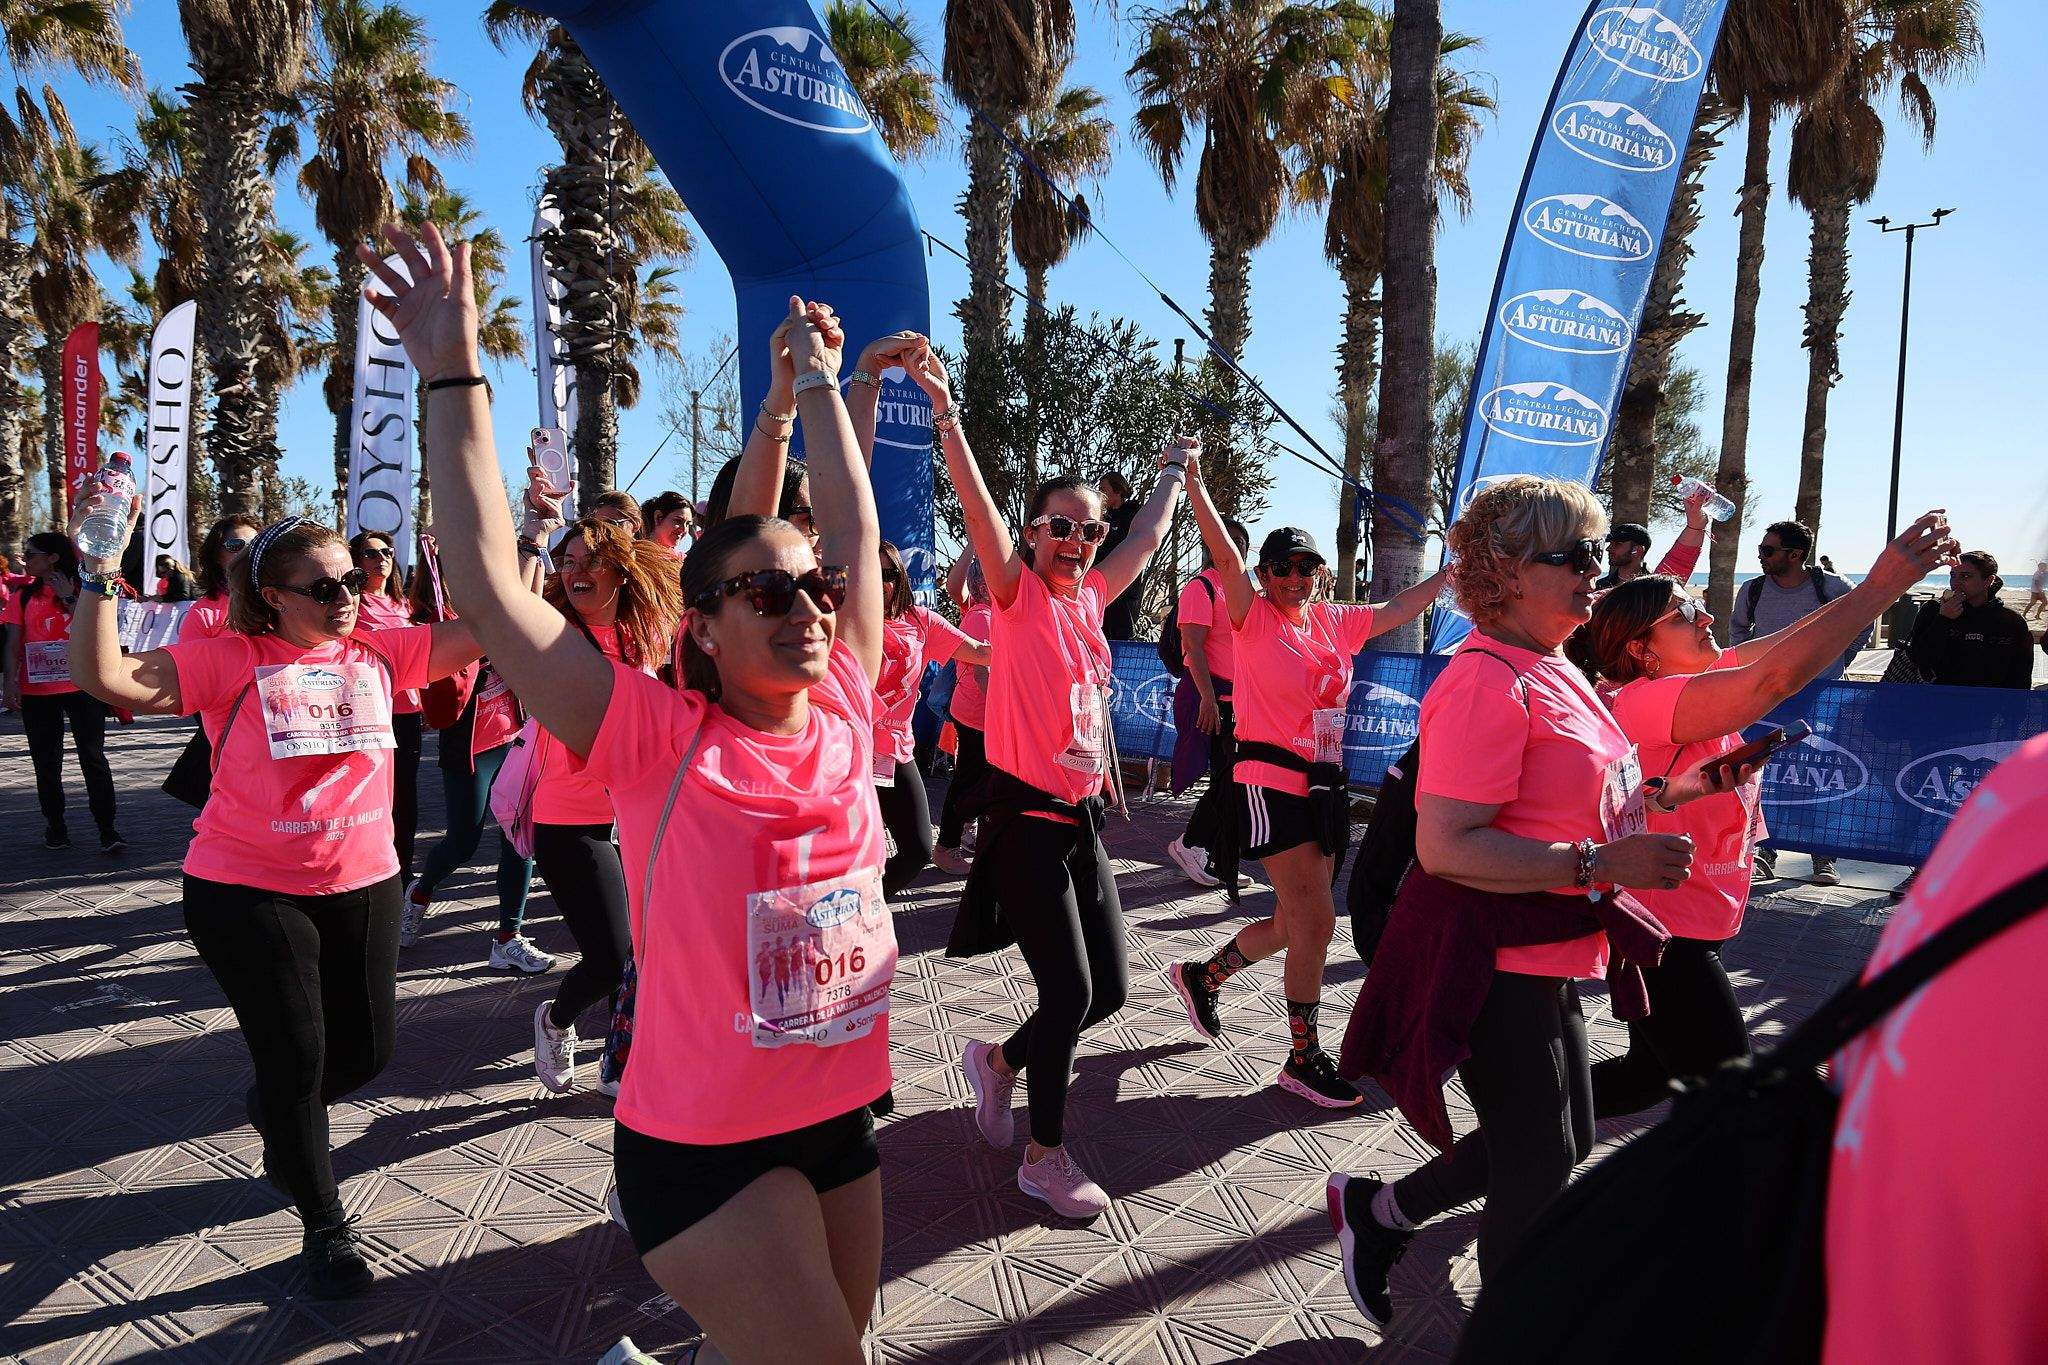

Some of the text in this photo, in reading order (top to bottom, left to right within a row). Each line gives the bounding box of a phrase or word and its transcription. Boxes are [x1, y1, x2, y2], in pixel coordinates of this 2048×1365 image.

[1594, 19, 1689, 76] ASTURIANA
[770, 50, 823, 76] CENTRAL
[733, 47, 869, 122] ASTURIANA
[1559, 111, 1665, 166] ASTURIANA
[1584, 114, 1665, 147] CENTRAL LECHERA
[1531, 206, 1642, 255] ASTURIANA
[1557, 208, 1641, 237] CENTRAL LECHERA
[1507, 303, 1622, 347] ASTURIANA
[1532, 304, 1622, 329] CENTRAL LECHERA
[880, 387, 917, 400] ENTRAL
[74, 354, 89, 470] Santander
[1487, 396, 1600, 439] ASTURIANA
[1509, 397, 1600, 420] CENTRAL LECHERA
[151, 347, 187, 550] OYSHO
[301, 677, 343, 687] ASTURIANA
[307, 702, 354, 720] 016
[319, 722, 342, 730] 9315
[286, 740, 325, 752] OYSHO
[347, 736, 383, 747] Santander
[1775, 750, 1843, 765] ECHERA
[271, 806, 384, 834] CARRERA DE LA MUJER
[325, 830, 345, 842] 2025
[763, 919, 799, 934] SUMA
[815, 946, 866, 985] 016
[826, 984, 851, 1003] 7378
[778, 1013, 815, 1029] CARRERA
[816, 1012, 826, 1022] DE
[826, 1007, 836, 1019] LA
